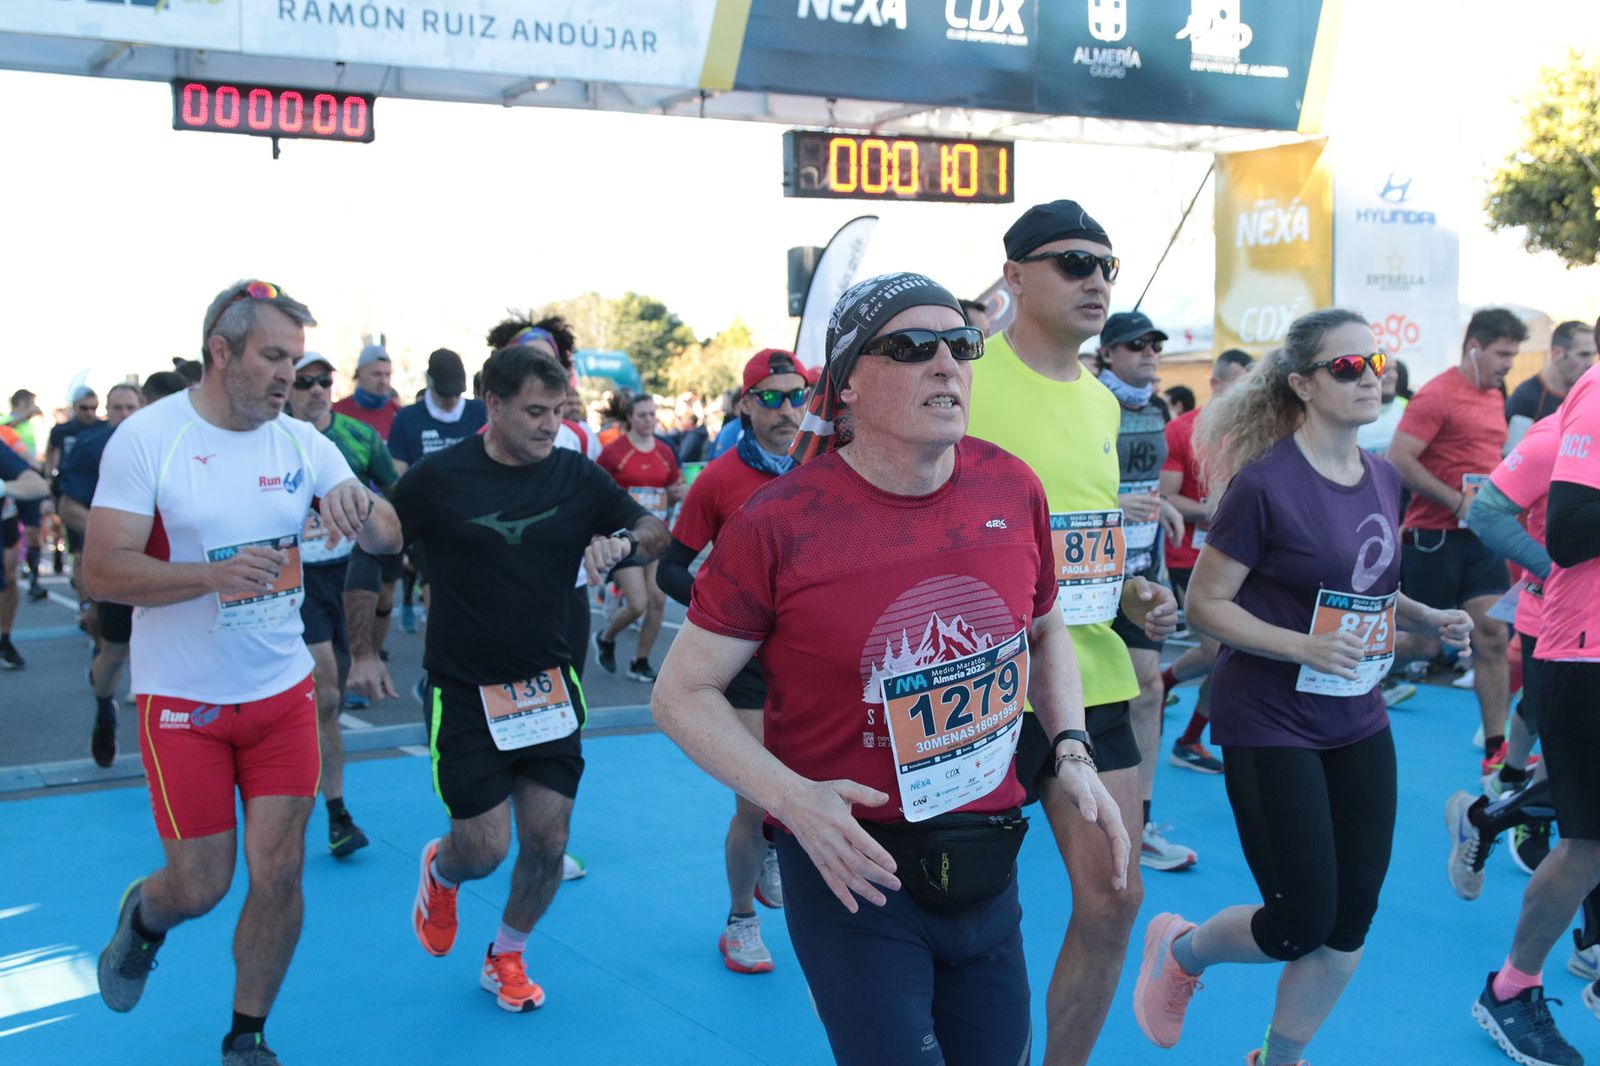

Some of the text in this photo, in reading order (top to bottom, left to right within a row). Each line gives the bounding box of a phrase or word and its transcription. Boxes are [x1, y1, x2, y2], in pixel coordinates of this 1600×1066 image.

[278, 0, 659, 53] RAMÓN RUIZ ANDÚJAR
[1072, 46, 1142, 69] ALMERÍA
[1235, 204, 1310, 248] NEXA
[1355, 208, 1437, 225] HYUNDAI
[1365, 273, 1426, 285] ESTRELLA
[259, 476, 281, 487] Run
[1064, 529, 1116, 564] 874
[1061, 565, 1090, 575] PAOLA
[1340, 611, 1389, 644] 875
[932, 662, 987, 686] Almería 2022
[956, 656, 986, 671] Maratón
[503, 672, 553, 701] 136
[908, 660, 1020, 738] 1279
[159, 708, 191, 723] Run
[915, 700, 1019, 754] 30MENAS18091992
[910, 778, 932, 792] NEXA
